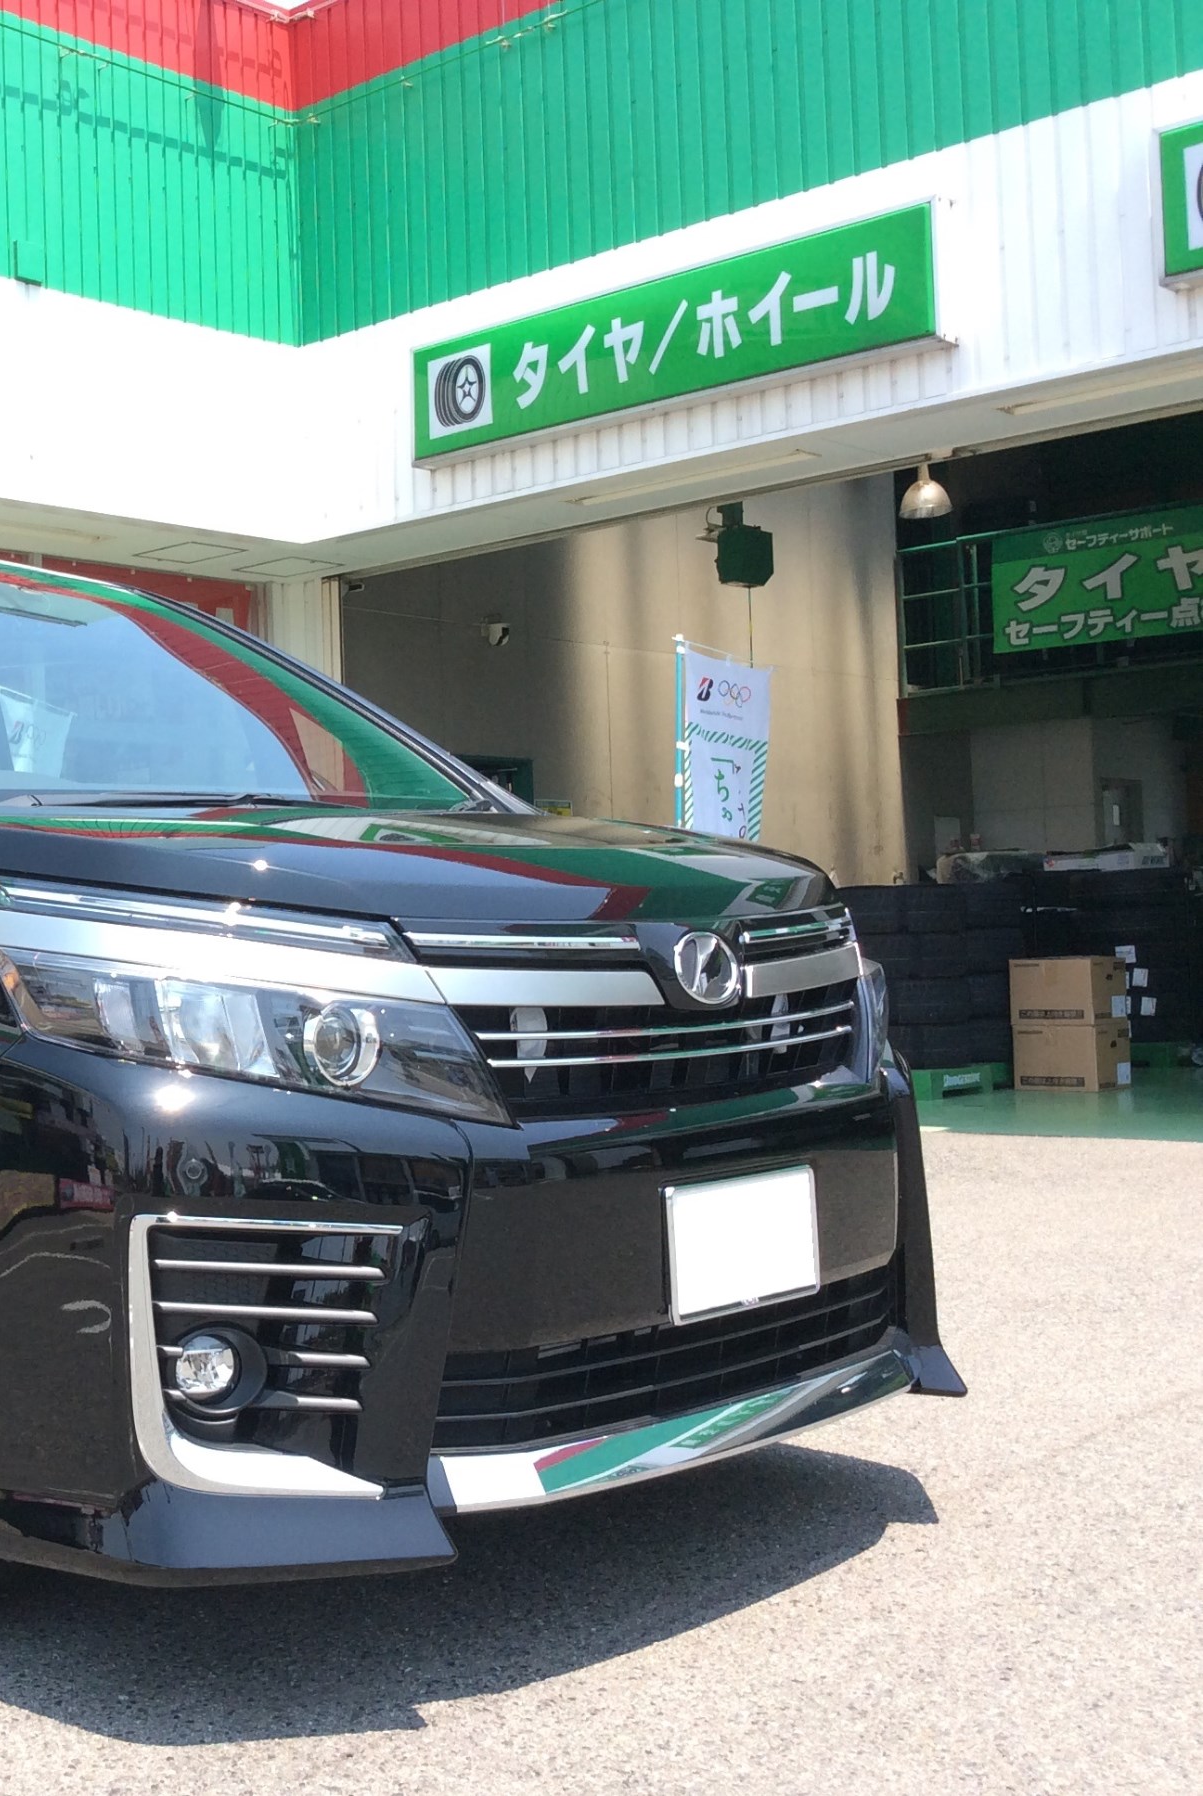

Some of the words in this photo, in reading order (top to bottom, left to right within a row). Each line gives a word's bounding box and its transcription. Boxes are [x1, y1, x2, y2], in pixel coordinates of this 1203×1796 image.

[1065, 524, 1174, 550] セーフティーサポート
[1005, 597, 1203, 646] セーフティー点
